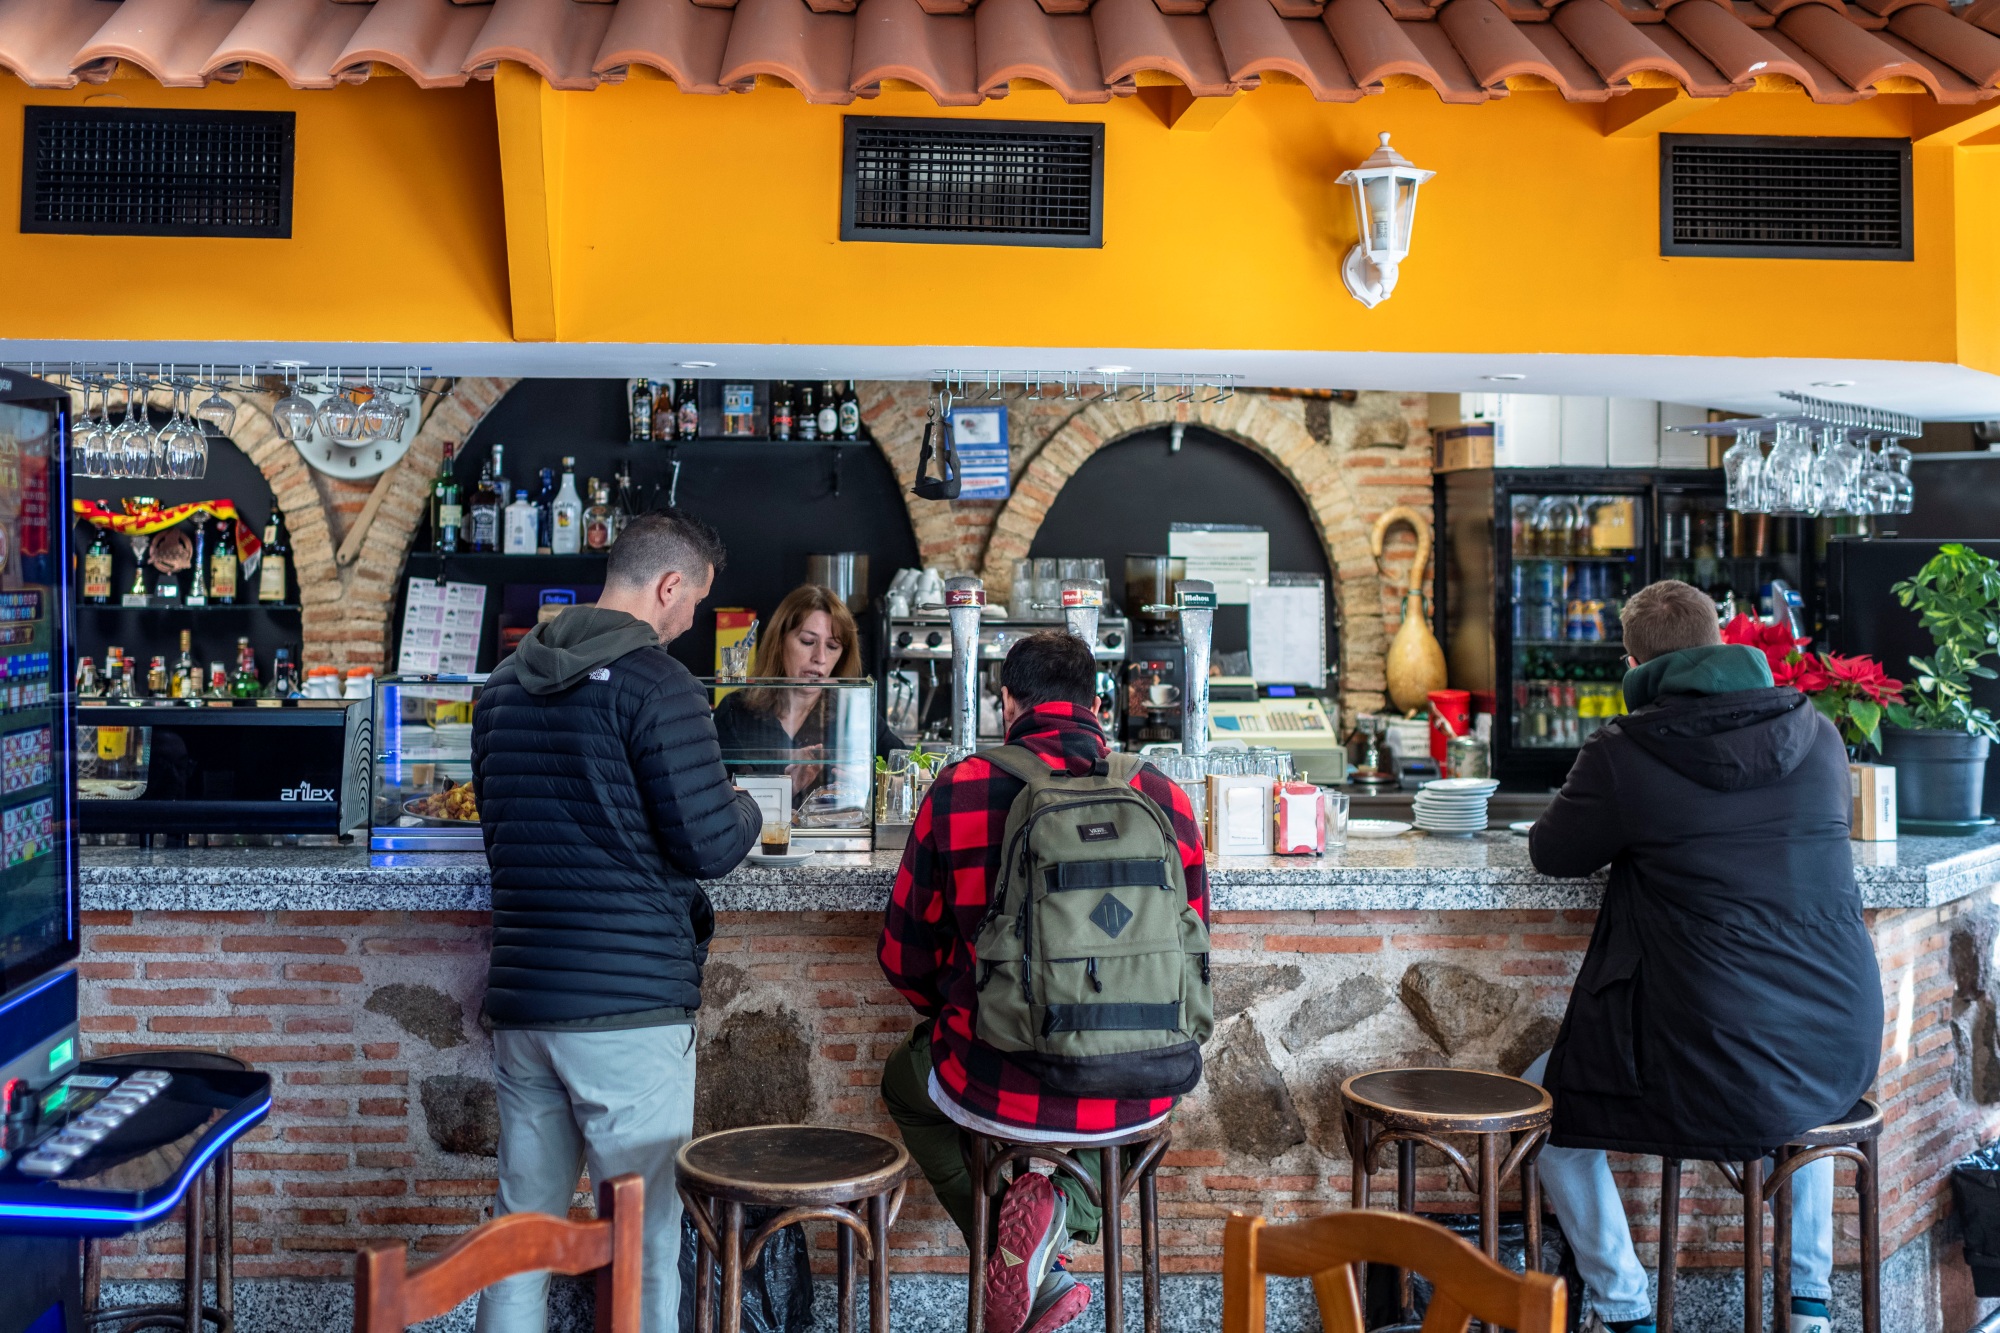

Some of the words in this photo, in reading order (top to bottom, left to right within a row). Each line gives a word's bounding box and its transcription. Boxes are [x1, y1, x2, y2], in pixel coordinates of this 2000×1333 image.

[325, 449, 332, 461] 7
[375, 449, 382, 460] 5
[349, 455, 357, 467] 6
[1185, 594, 1209, 602] Mahou
[281, 781, 335, 802] arilex
